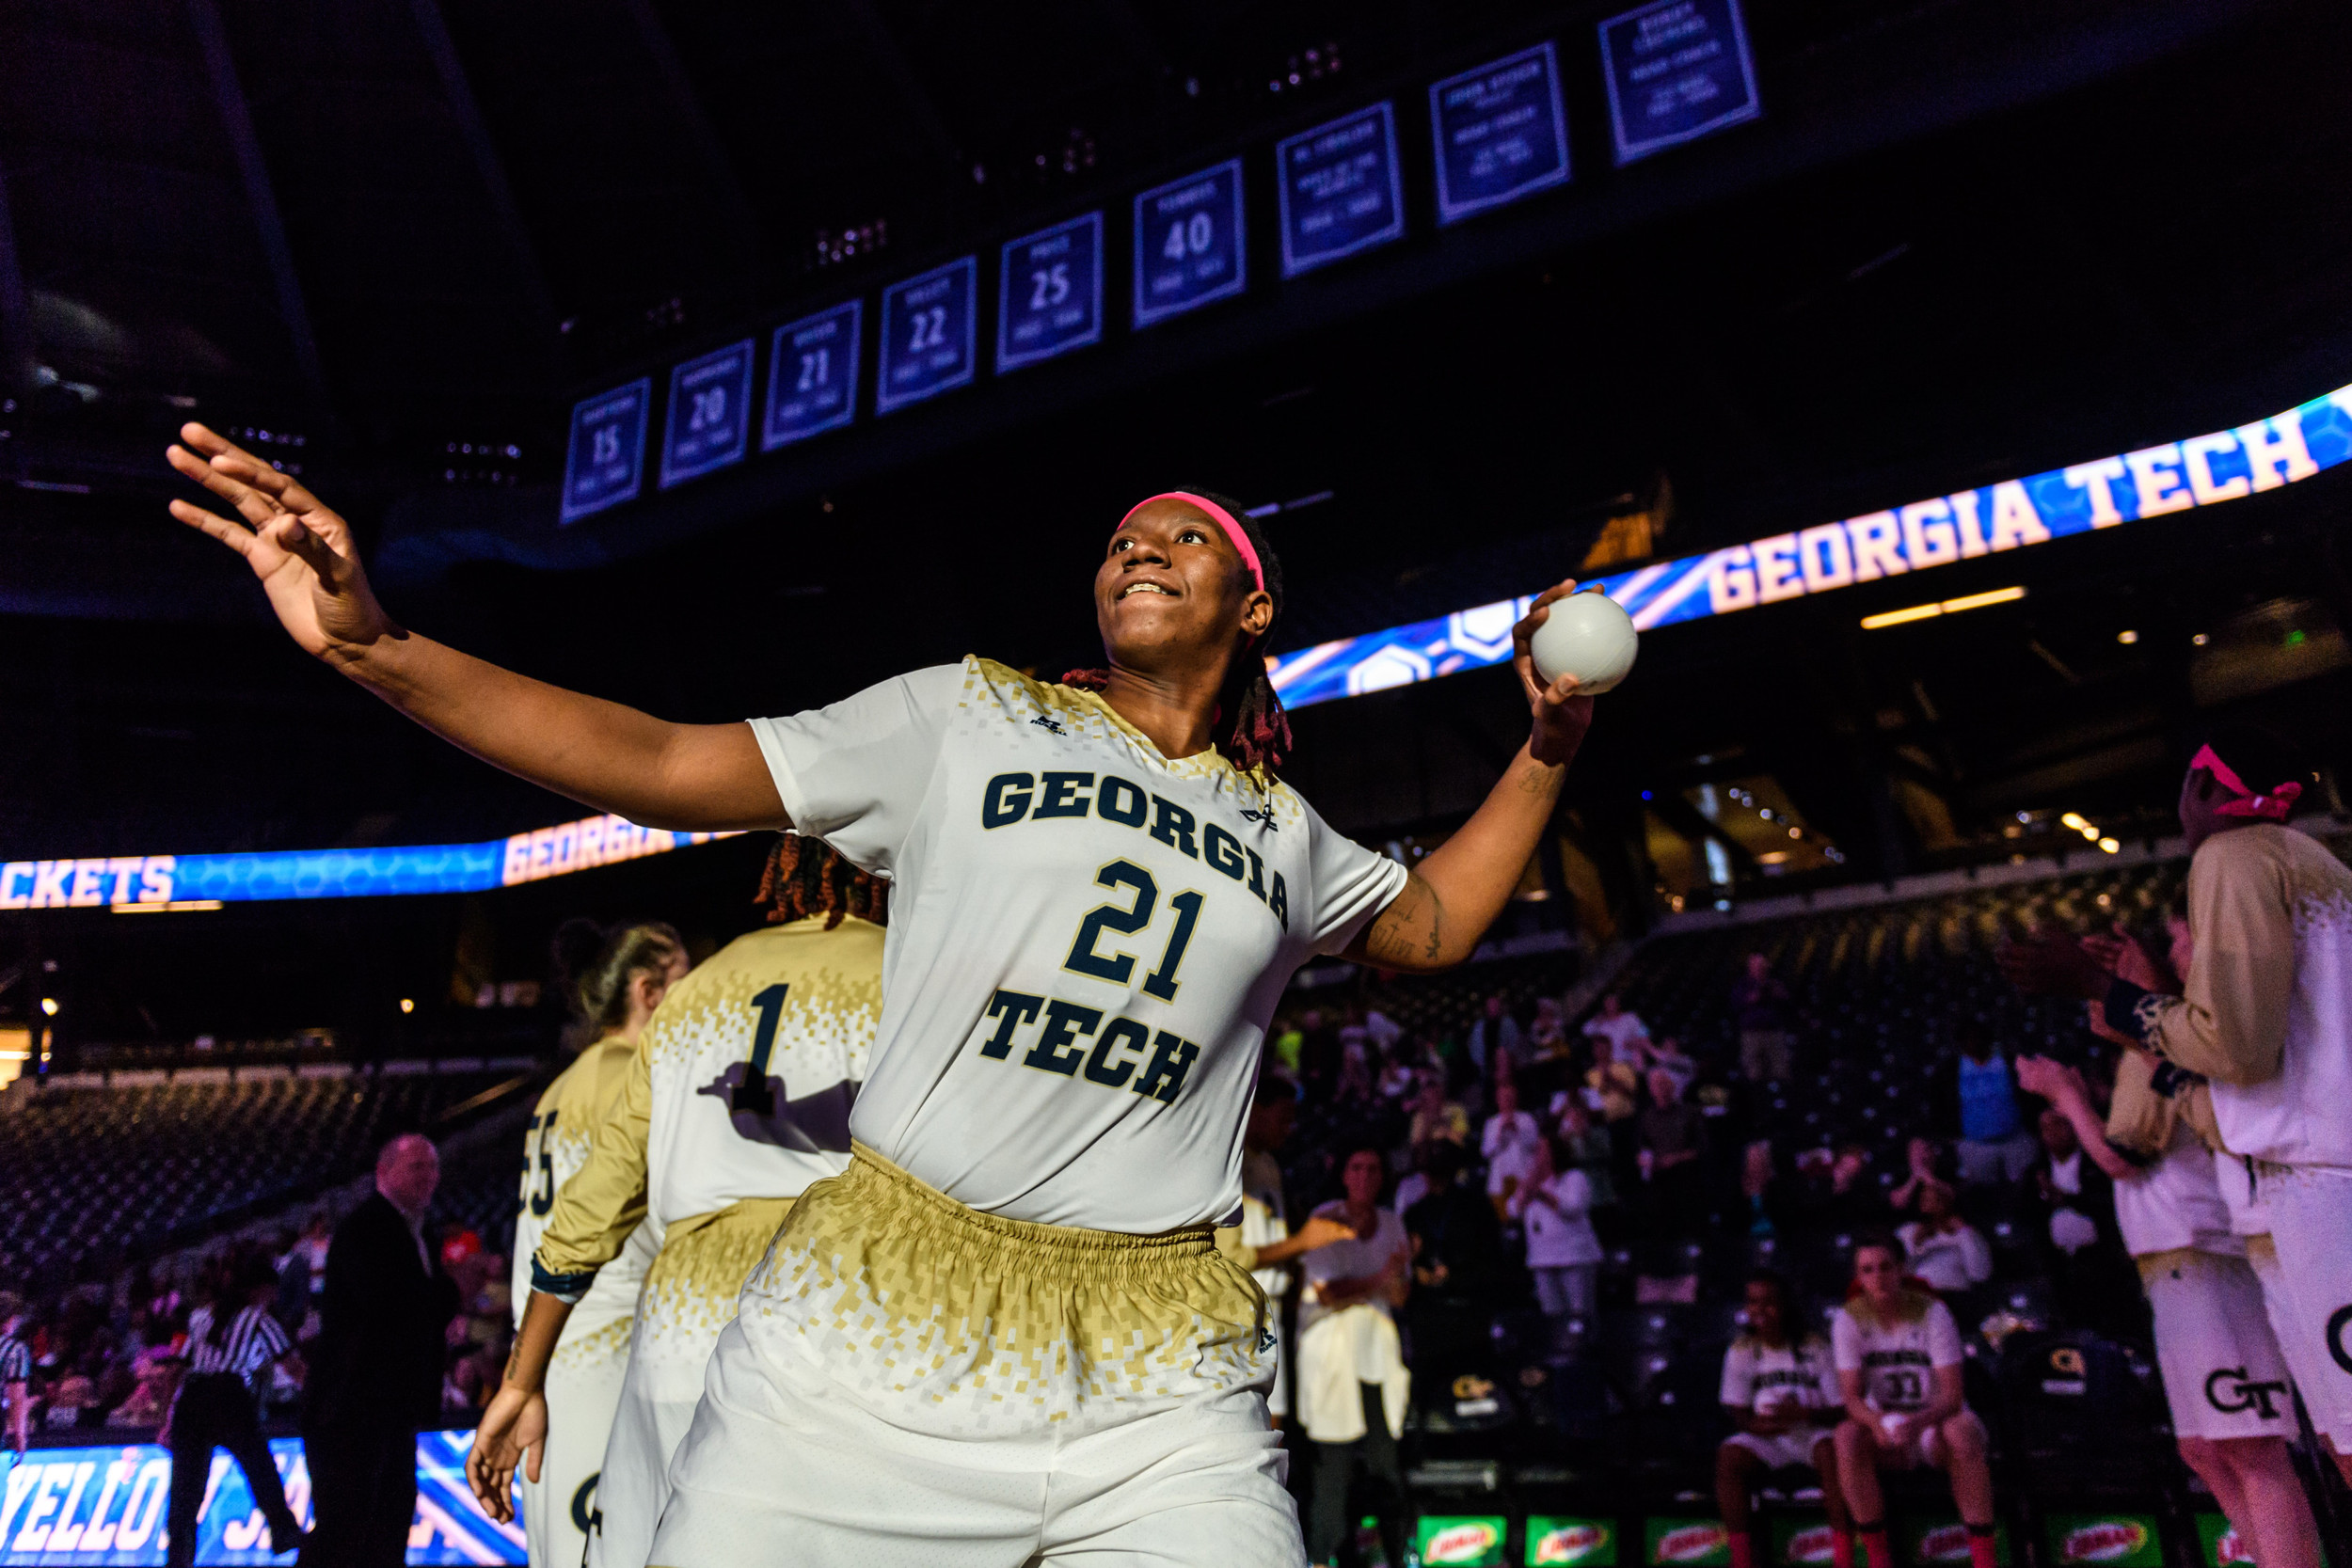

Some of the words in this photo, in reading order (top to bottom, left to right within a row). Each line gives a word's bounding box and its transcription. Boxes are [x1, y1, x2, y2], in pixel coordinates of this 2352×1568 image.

[1163, 211, 1214, 261] 40
[1029, 261, 1071, 310] 25
[908, 306, 946, 354] 22
[797, 348, 831, 392] 21
[690, 386, 727, 431] 20
[1708, 479, 2052, 614] GEORGIA
[2064, 414, 2319, 530] TECH
[981, 770, 1289, 935] GEORGIA
[1060, 856, 1207, 1006] 21
[730, 983, 789, 1117] 1
[978, 987, 1201, 1105] TECH
[2204, 1367, 2288, 1419] GT
[0, 1458, 171, 1551] YELLO
